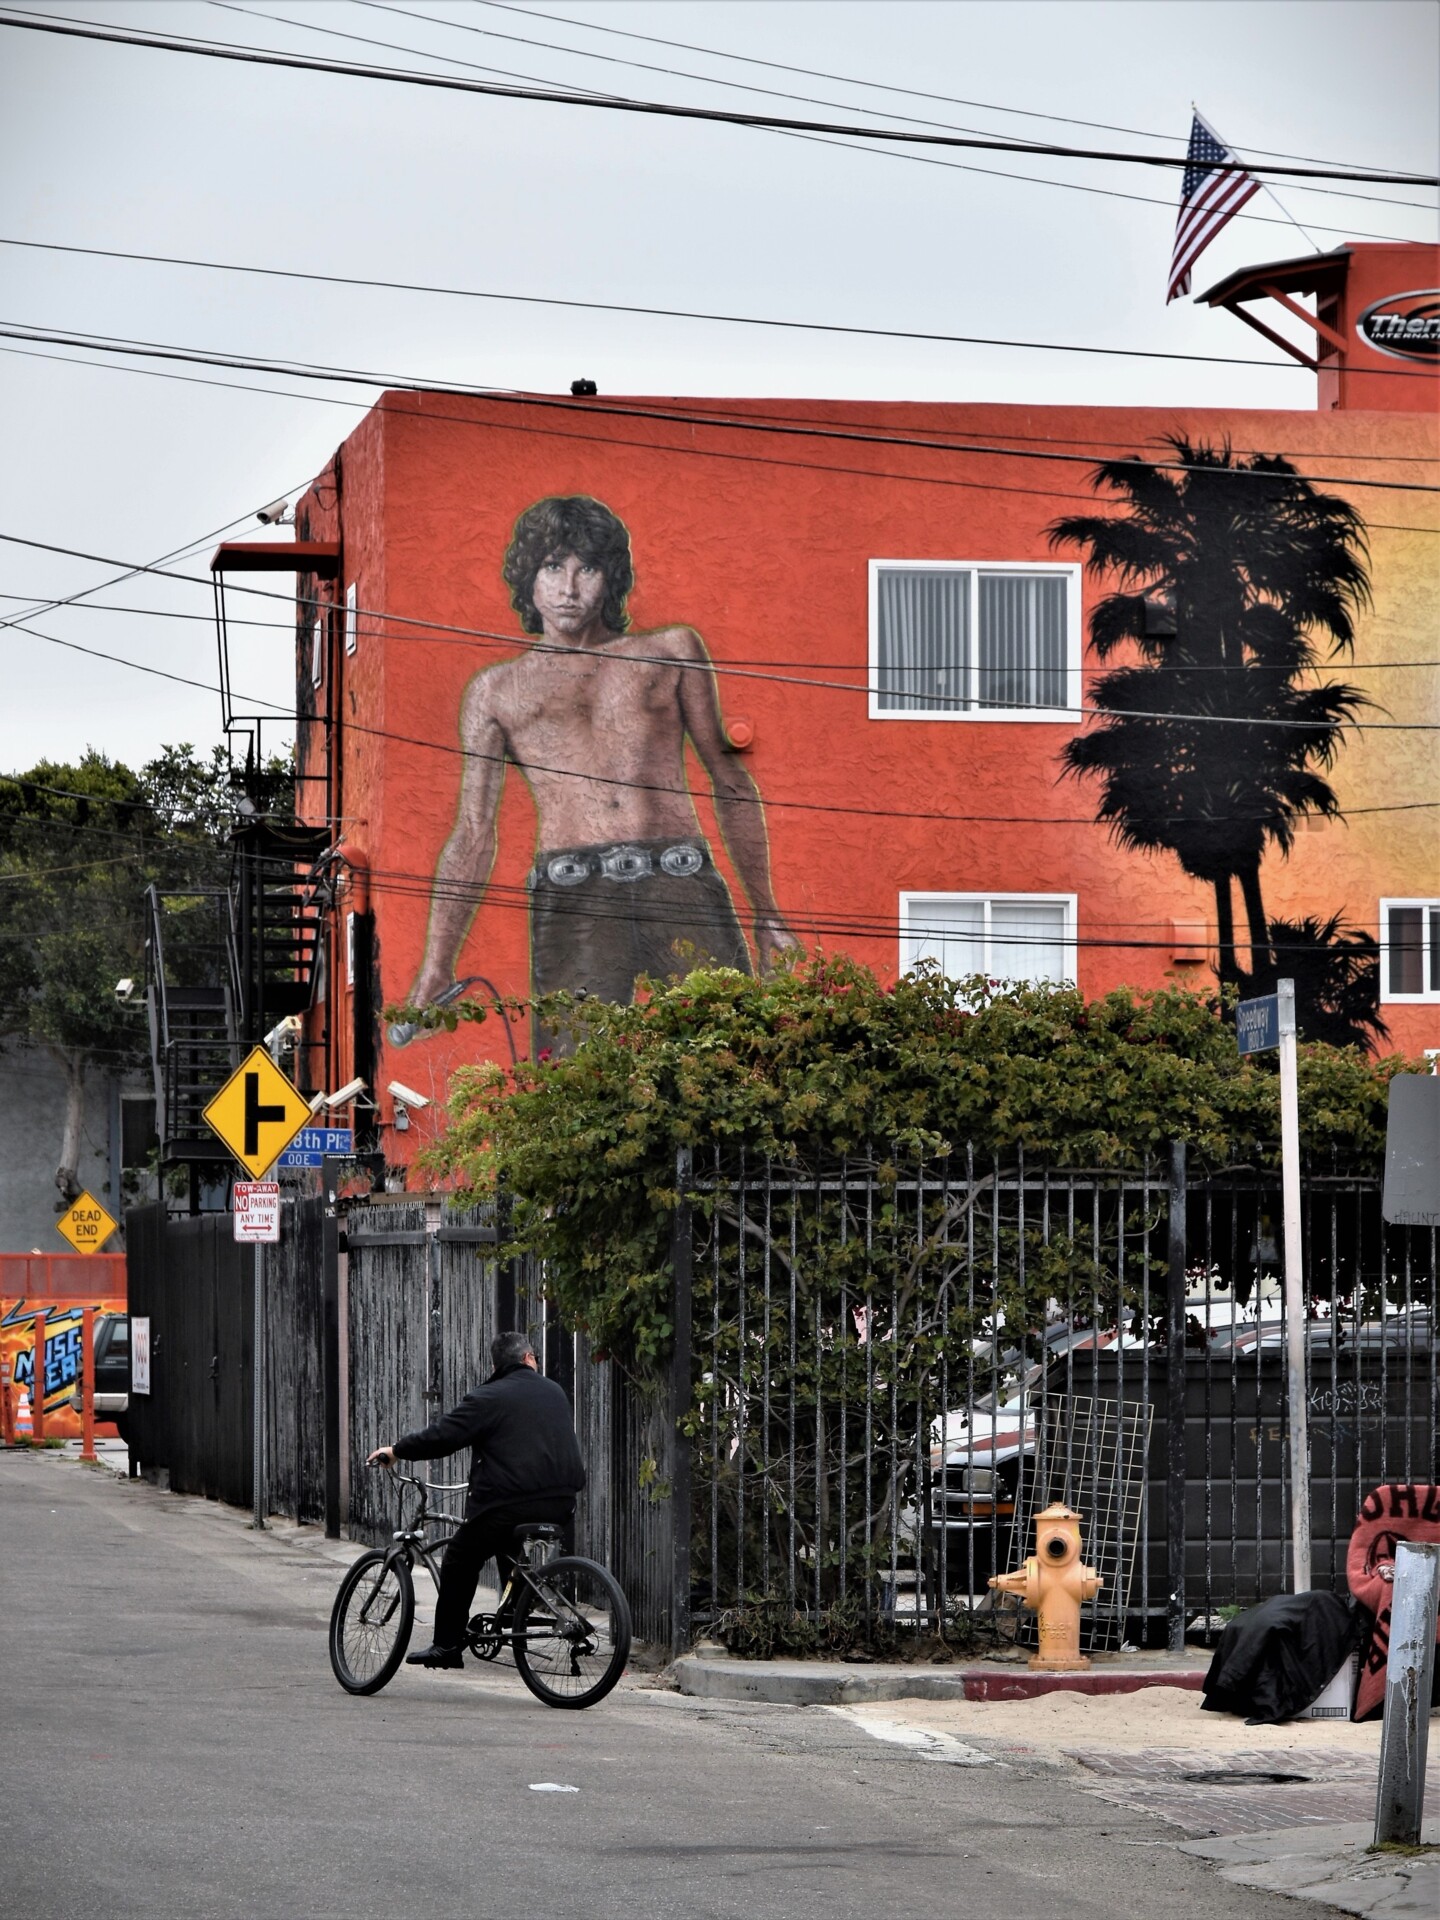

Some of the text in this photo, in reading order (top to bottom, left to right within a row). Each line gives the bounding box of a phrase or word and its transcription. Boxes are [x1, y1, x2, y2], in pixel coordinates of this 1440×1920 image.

[1370, 314, 1440, 333] Ther
[1238, 1004, 1269, 1034] Speedway
[288, 1132, 320, 1149] 8th
[236, 1184, 277, 1193] TOW-AWAY
[235, 1195, 277, 1211] NO PARKING
[72, 1210, 102, 1222] DEAD
[240, 1213, 274, 1223] ANY TIME
[76, 1224, 98, 1236] END
